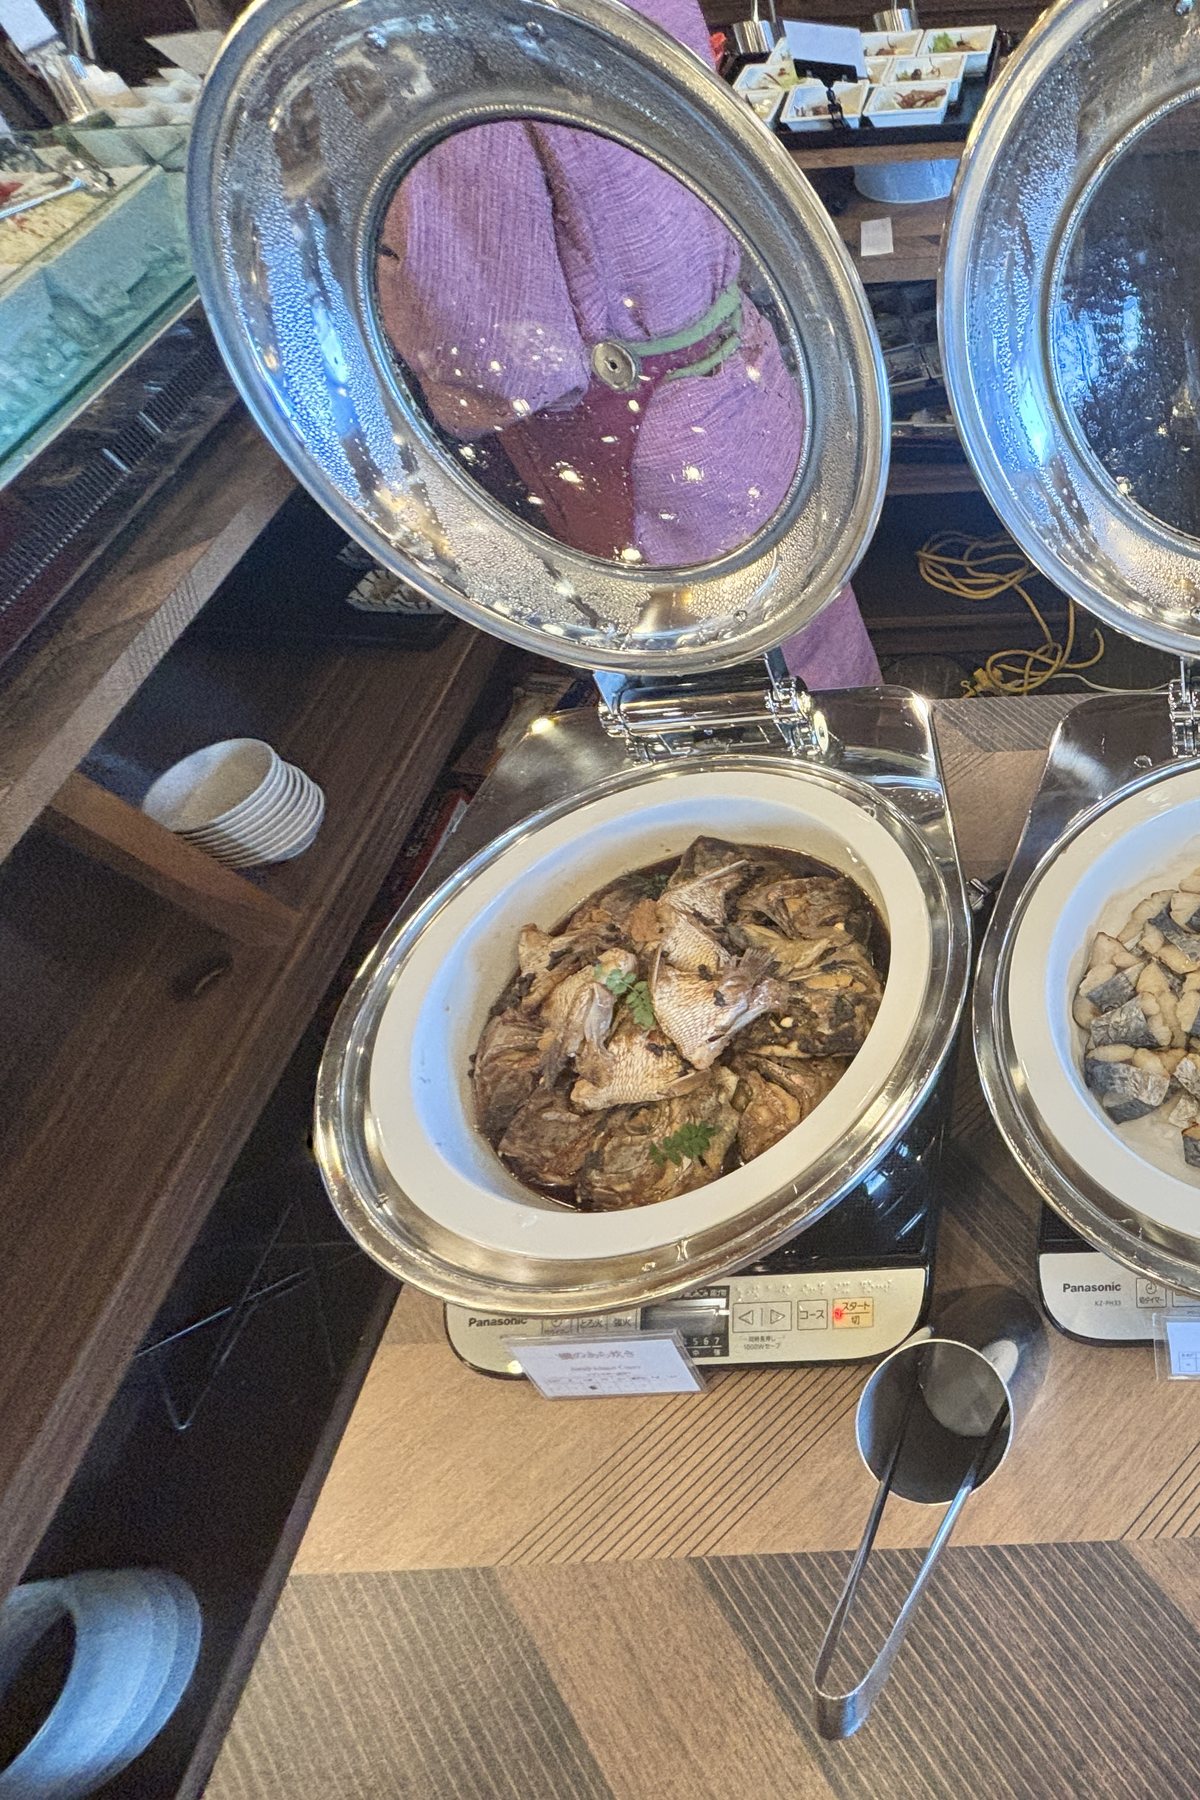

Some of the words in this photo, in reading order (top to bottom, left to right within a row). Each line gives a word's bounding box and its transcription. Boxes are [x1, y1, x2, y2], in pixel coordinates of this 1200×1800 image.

[1062, 1281, 1121, 1293] Panasonic
[842, 1301, 870, 1311] スタート
[799, 1309, 825, 1320] コース
[468, 1317, 528, 1327] Panasonic
